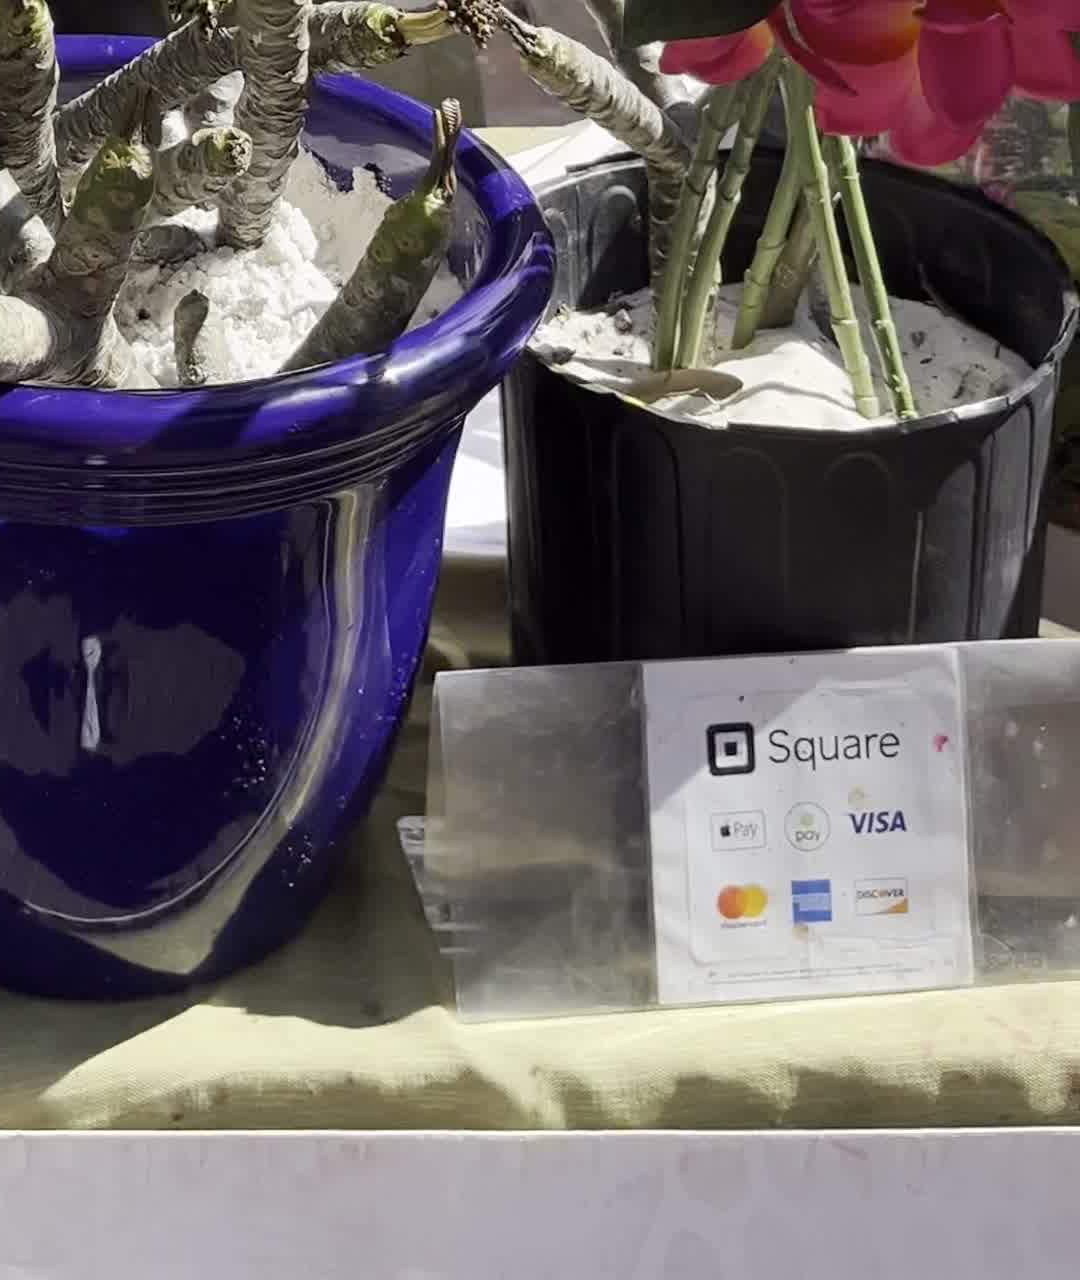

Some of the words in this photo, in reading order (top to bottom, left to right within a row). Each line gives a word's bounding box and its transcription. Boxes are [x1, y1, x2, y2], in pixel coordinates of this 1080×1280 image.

[768, 729, 901, 771] Square
[733, 822, 759, 843] Pay
[848, 810, 908, 835] VISA
